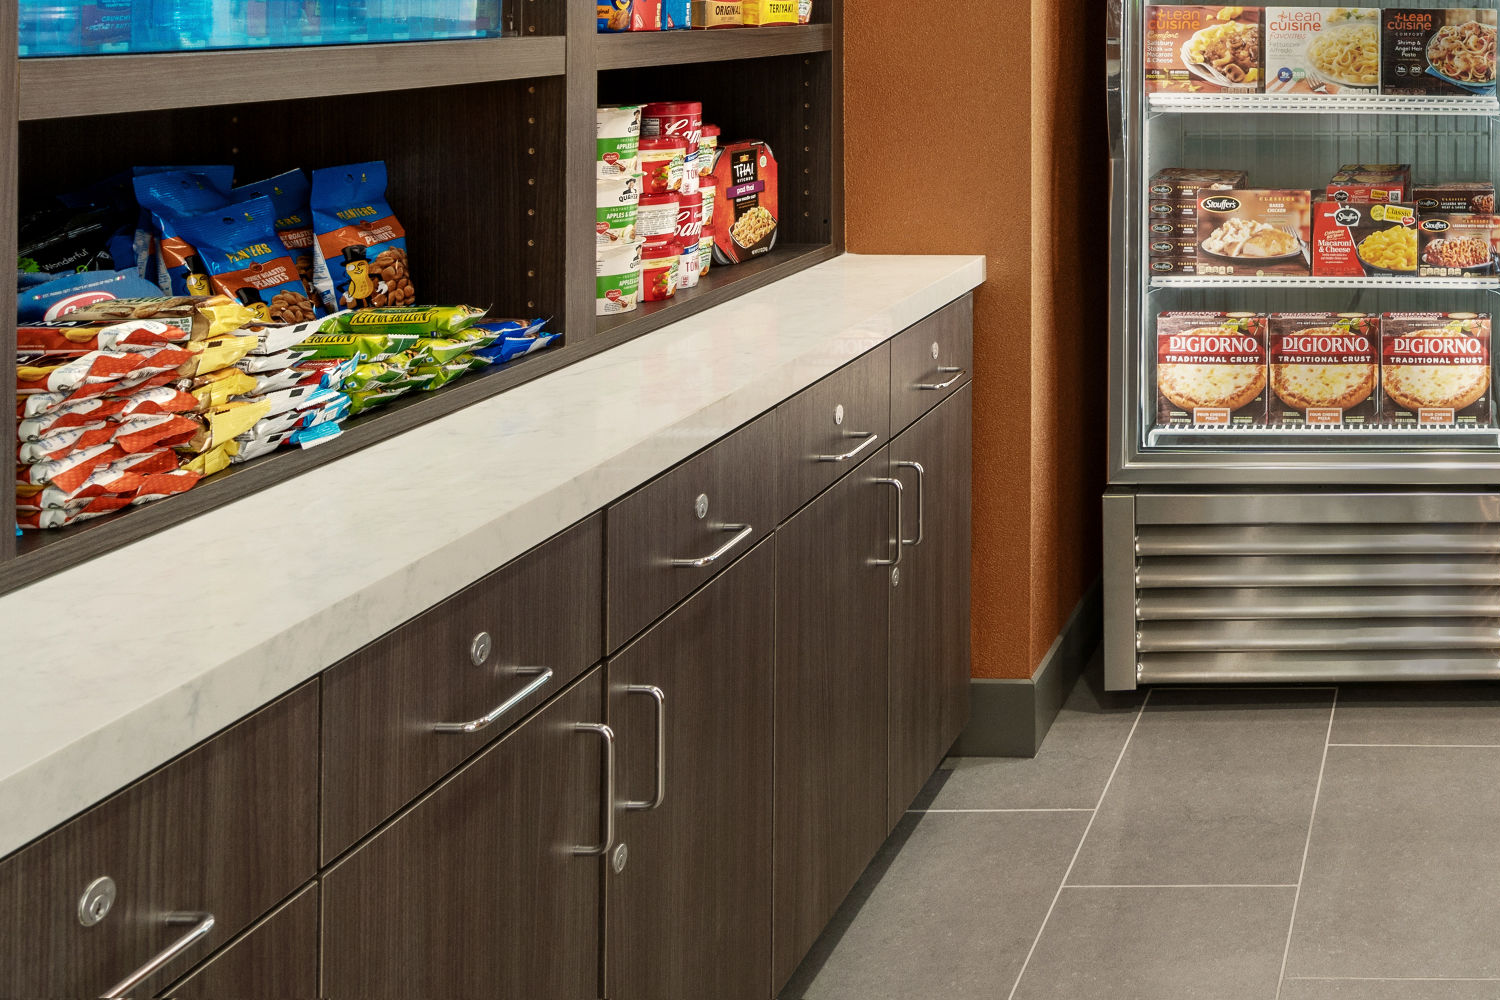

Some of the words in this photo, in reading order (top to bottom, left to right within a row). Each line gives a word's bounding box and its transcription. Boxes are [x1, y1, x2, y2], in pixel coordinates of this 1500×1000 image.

[715, 5, 741, 16] ORIGINAL
[769, 3, 794, 14] TERIYAKI
[1167, 10, 1201, 20] Lean
[1289, 11, 1321, 21] Lean
[1404, 13, 1432, 22] Lean
[733, 161, 755, 178] THAI
[736, 186, 748, 196] pad
[1206, 199, 1237, 211] Stouffer's
[606, 212, 624, 220] APPLES
[1386, 206, 1412, 217] Classic
[1424, 220, 1448, 230] Stouffer's
[366, 230, 397, 246] PEANUTS
[1317, 239, 1352, 247] Macaroni
[41, 248, 90, 272] Wonderful
[262, 266, 287, 280] ROASTED
[251, 273, 290, 289] PEANUTS
[351, 312, 388, 325] VALLEY
[387, 311, 430, 325] NATURE
[1165, 355, 1227, 363] TRADITIONAL
[1278, 355, 1340, 363] TRADITIONAL
[1342, 355, 1371, 363] CRUST
